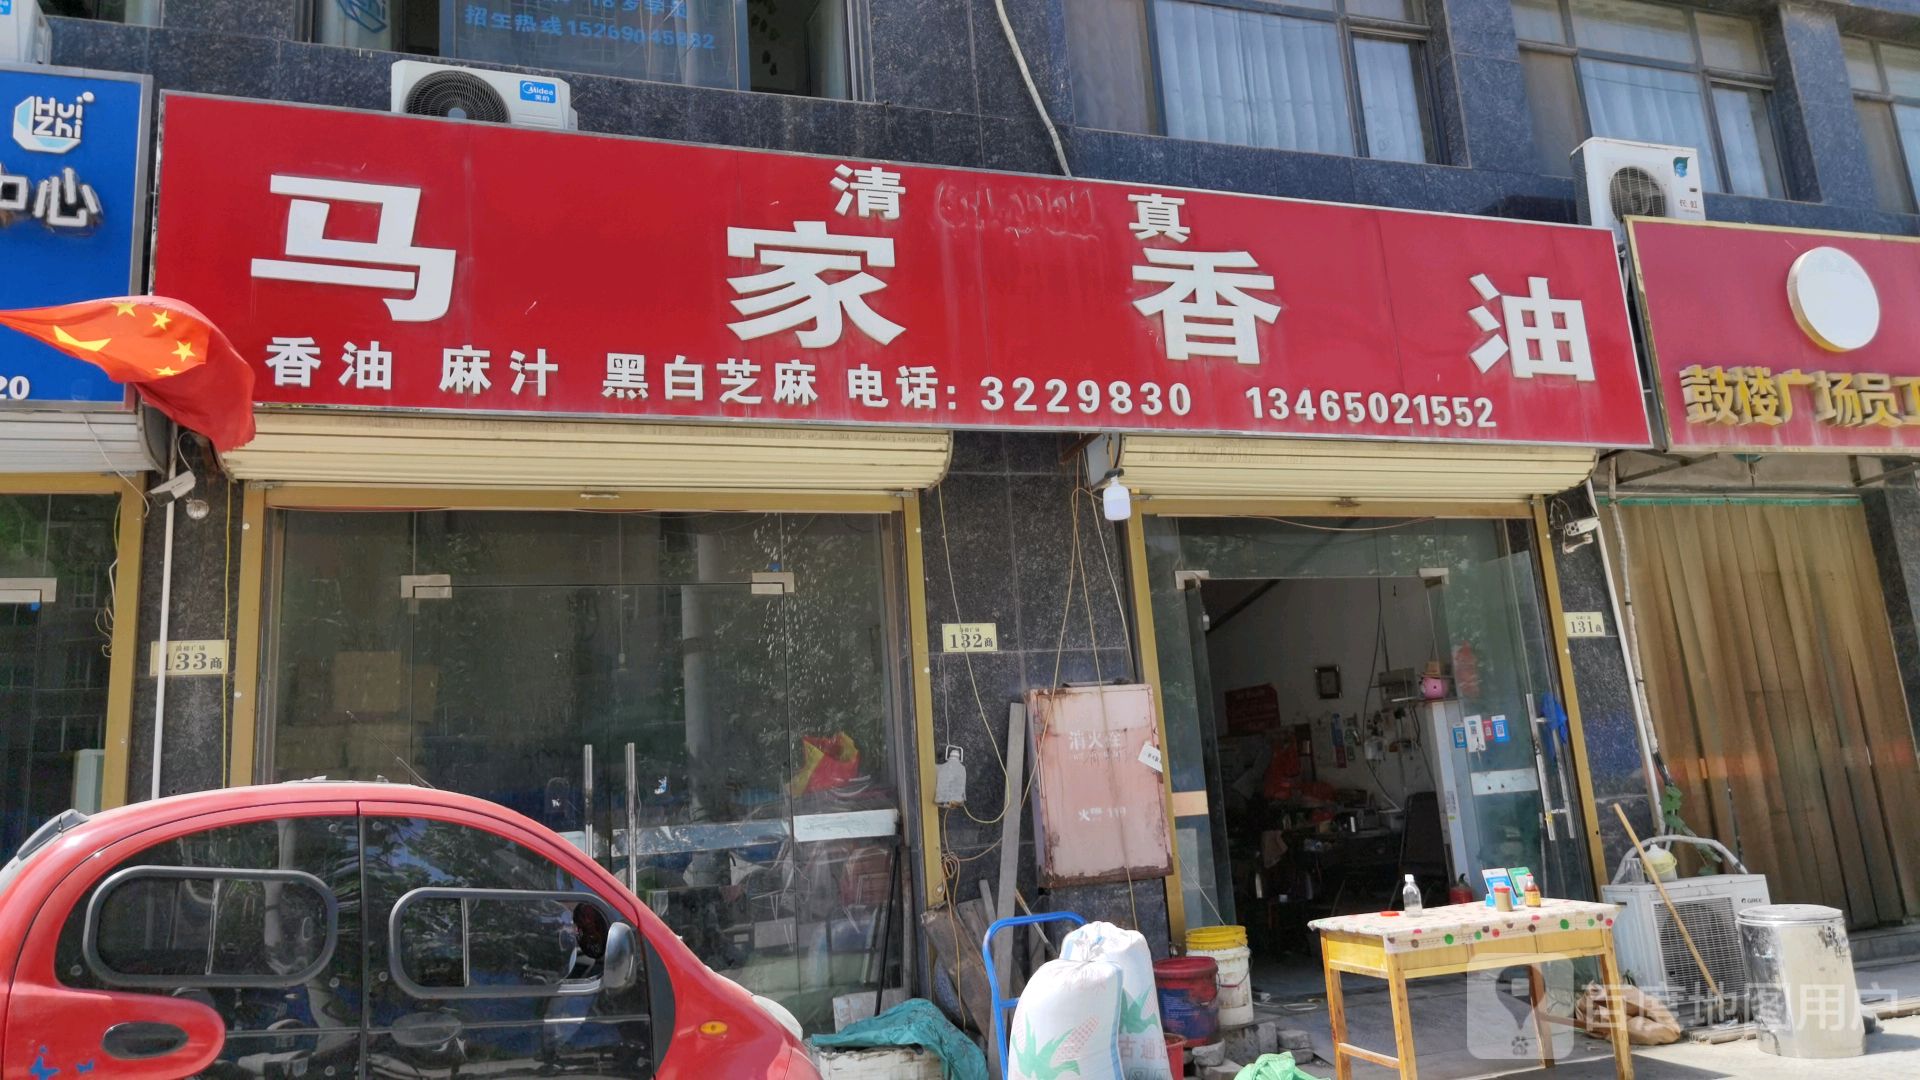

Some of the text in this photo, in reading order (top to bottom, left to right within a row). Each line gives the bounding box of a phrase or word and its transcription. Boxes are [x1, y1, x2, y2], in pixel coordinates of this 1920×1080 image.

[35, 95, 83, 119] Hui
[33, 115, 83, 139] Zhi
[265, 336, 394, 391] 香油
[438, 344, 559, 397] 麻汁
[601, 352, 820, 407] 黑白芝麻
[1244, 386, 1498, 429] 13465021552
